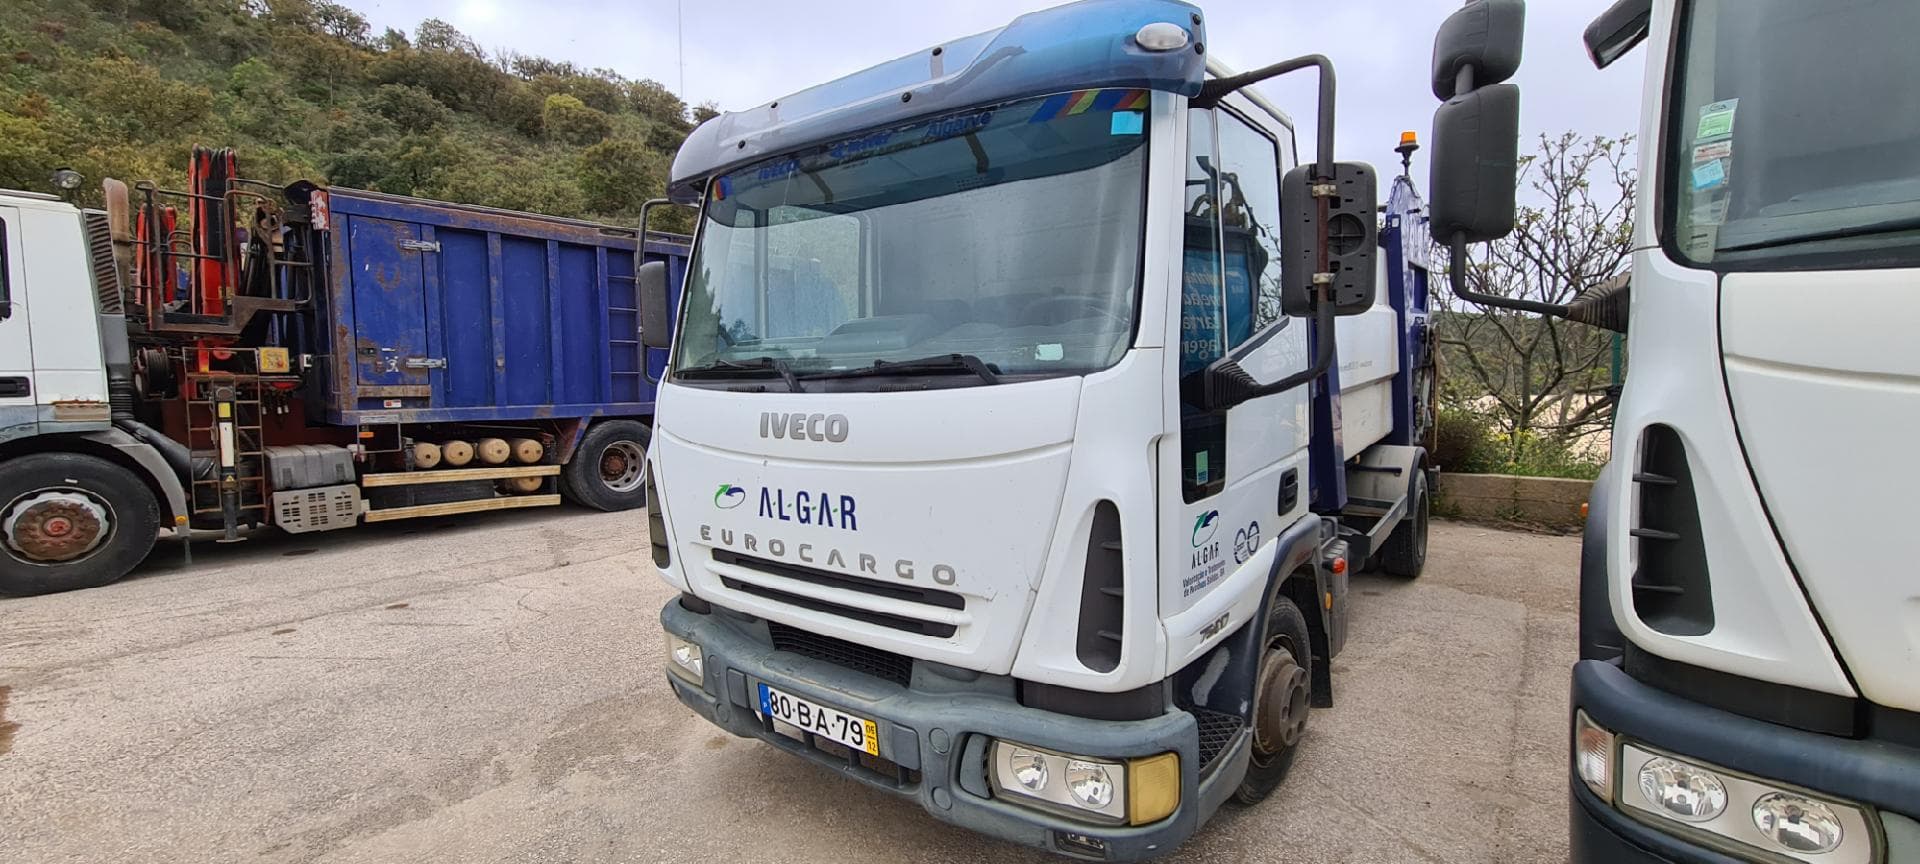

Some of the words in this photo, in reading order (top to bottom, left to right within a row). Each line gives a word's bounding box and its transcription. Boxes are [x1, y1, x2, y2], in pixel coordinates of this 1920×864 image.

[760, 412, 849, 443] IVECO
[700, 524, 956, 586] EUROCARGO
[868, 741, 876, 752] 12
